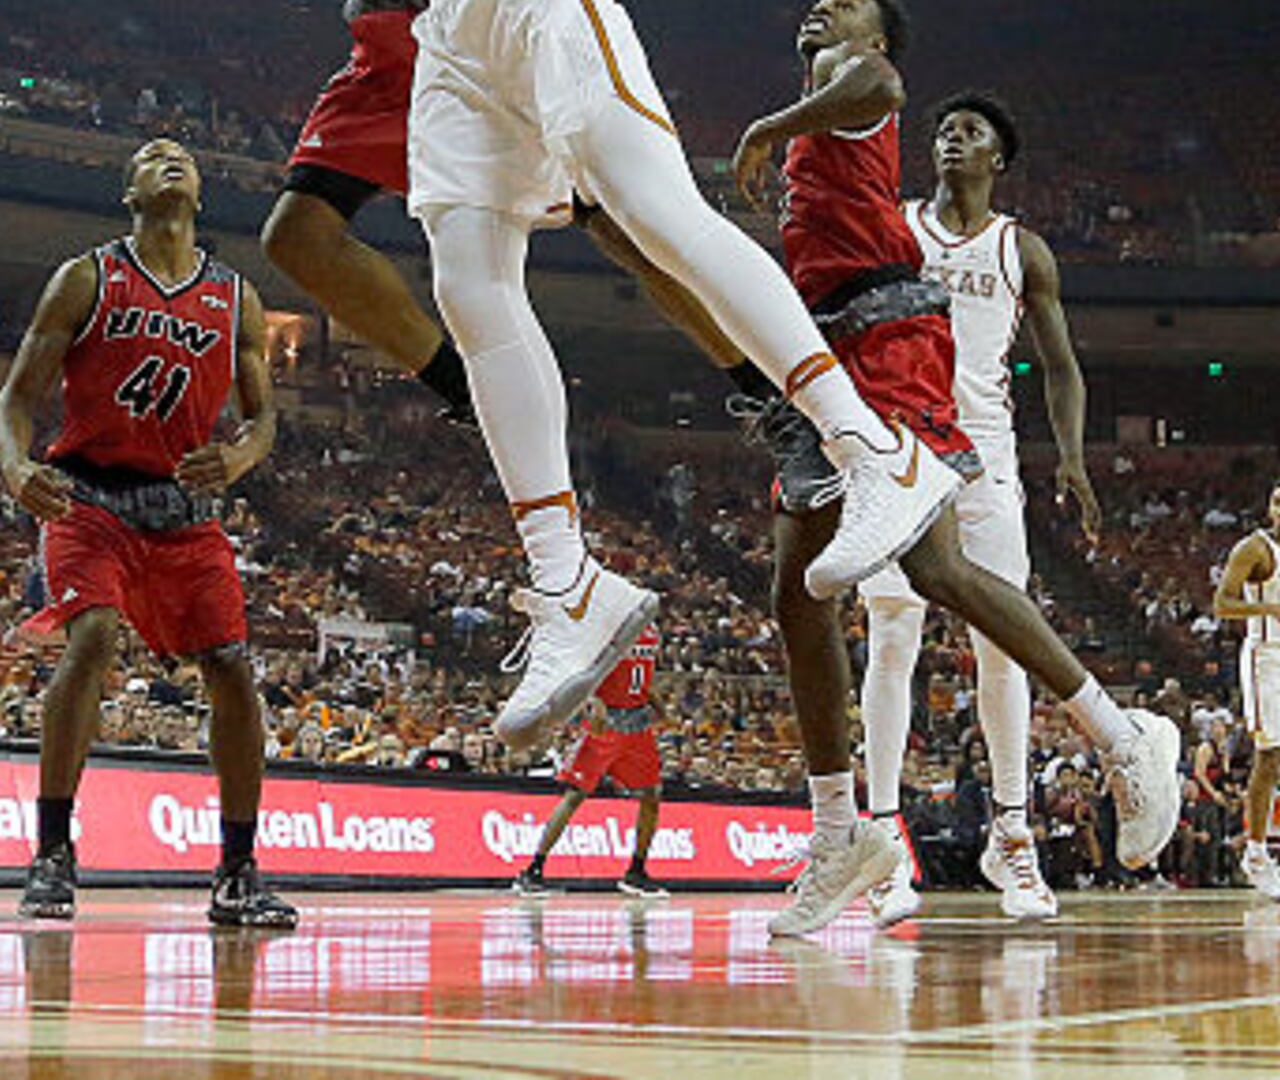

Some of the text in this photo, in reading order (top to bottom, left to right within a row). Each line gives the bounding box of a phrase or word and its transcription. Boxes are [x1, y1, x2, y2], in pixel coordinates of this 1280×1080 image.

[103, 305, 222, 358] UIW
[114, 355, 192, 422] 41
[318, 801, 435, 852] Loans
